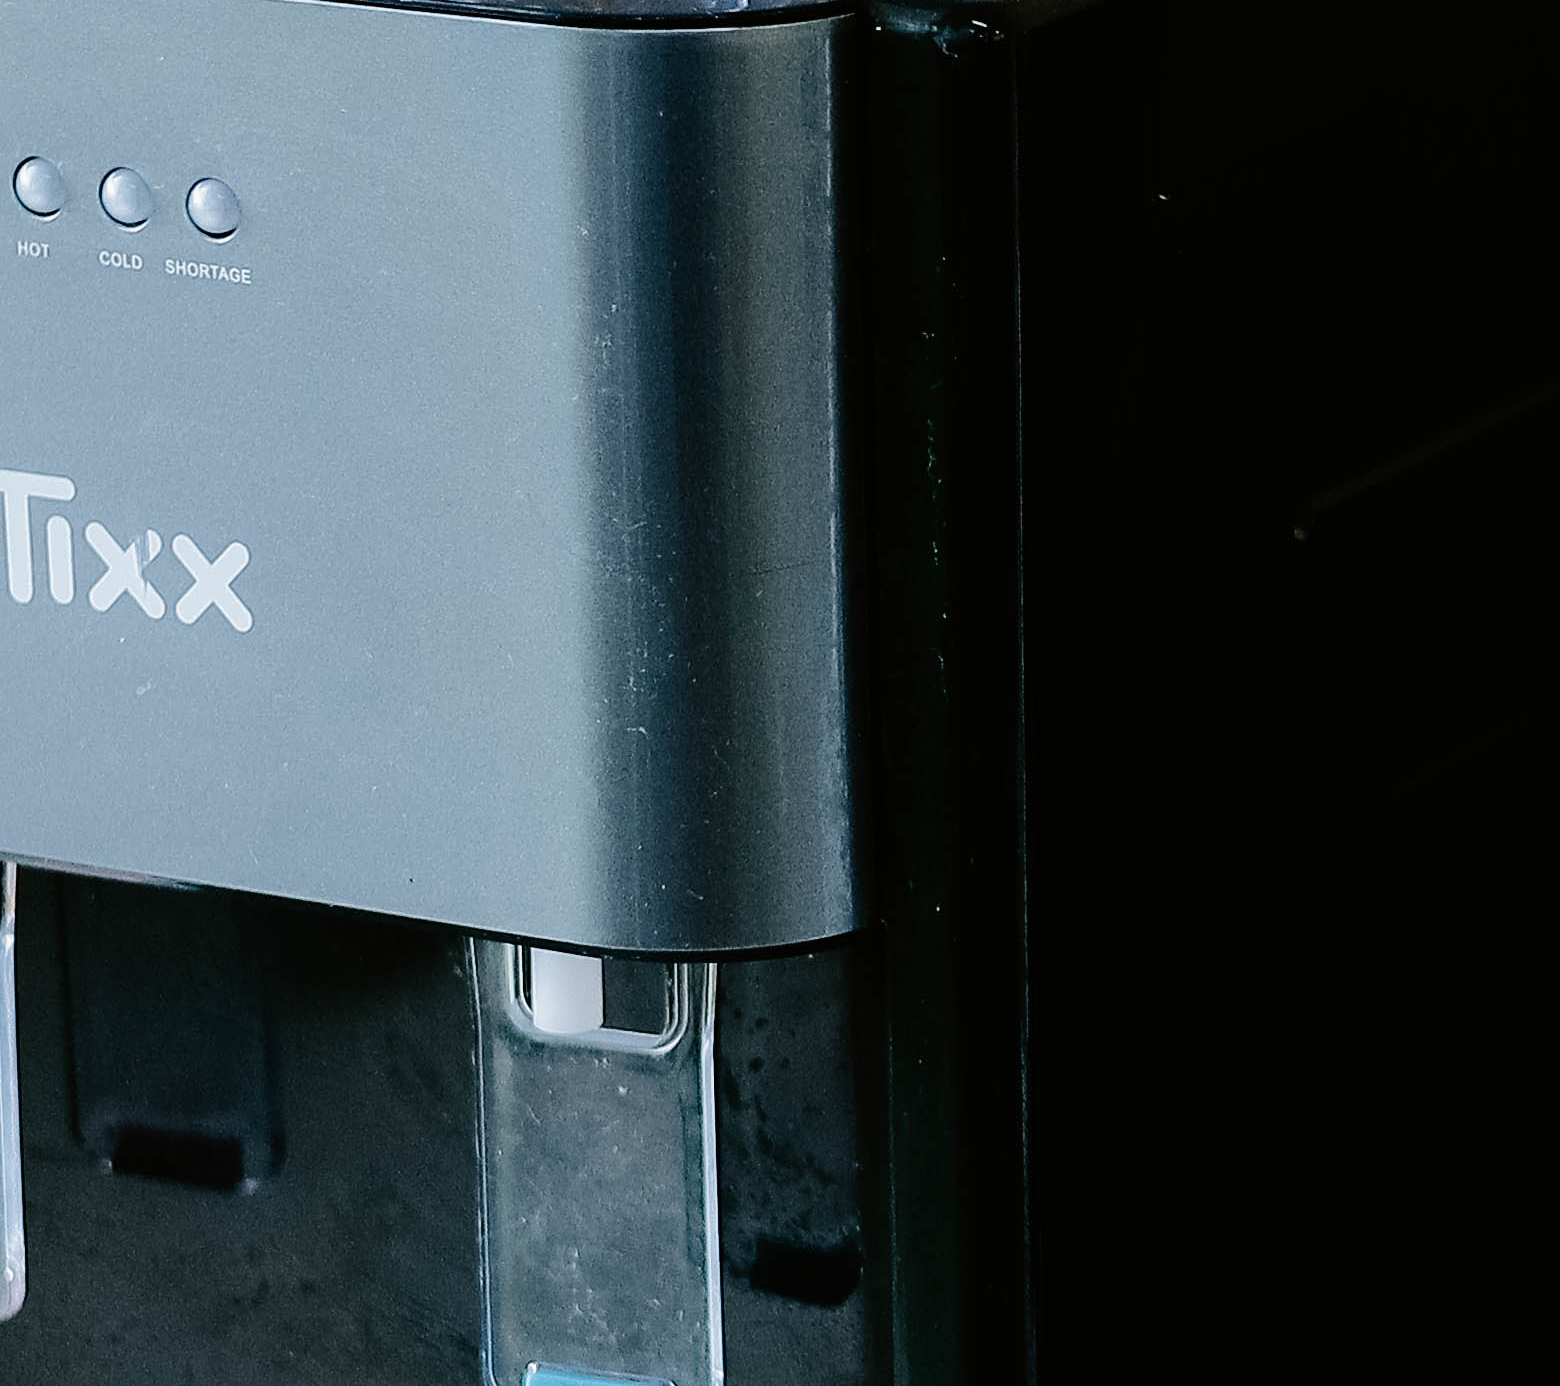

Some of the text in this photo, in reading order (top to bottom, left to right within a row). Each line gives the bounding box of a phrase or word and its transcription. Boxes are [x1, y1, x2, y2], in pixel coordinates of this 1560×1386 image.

[16, 240, 50, 259] HOT
[98, 250, 144, 271] COLD
[164, 259, 253, 285] SHORTAGE
